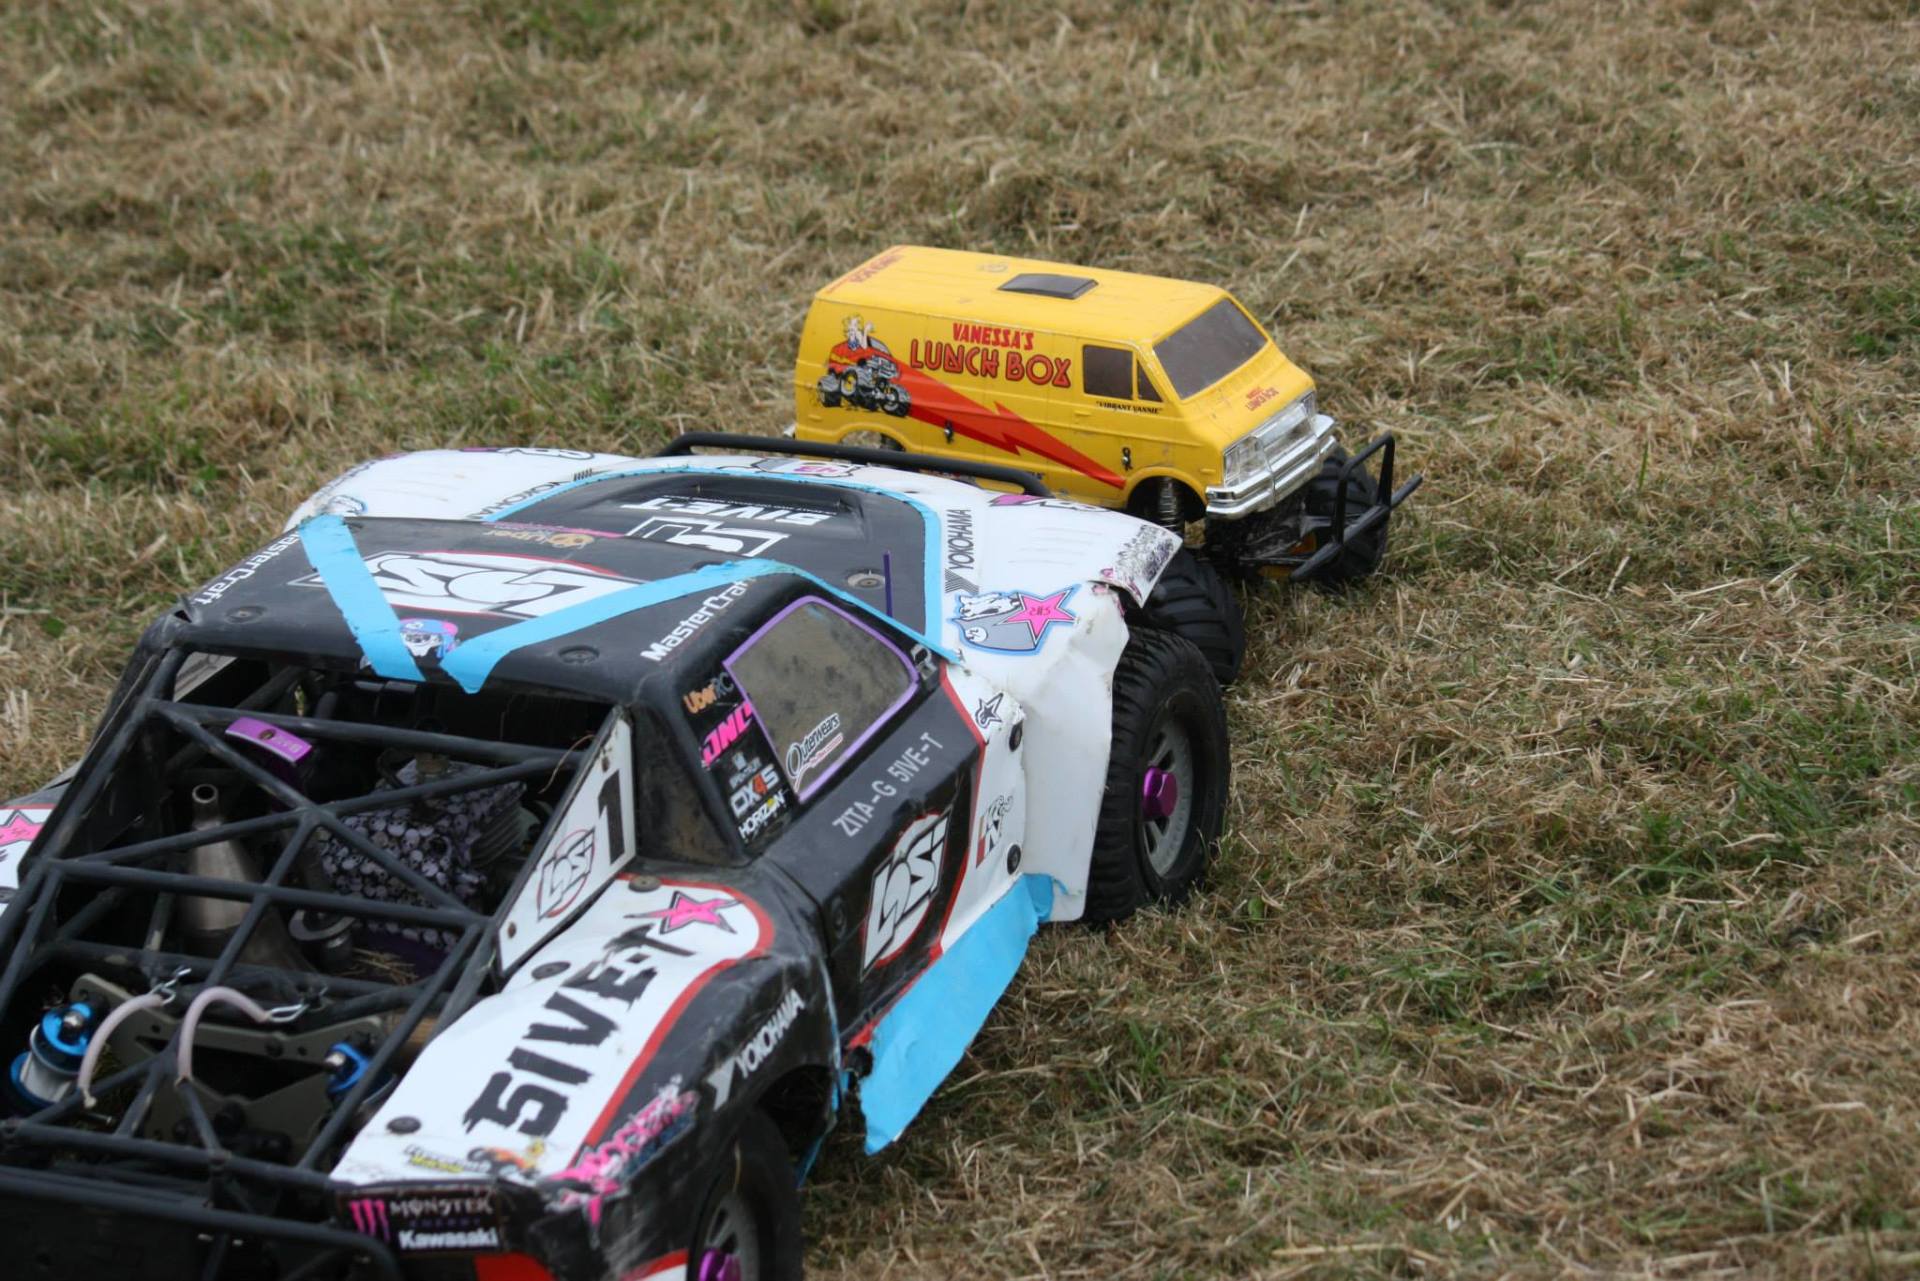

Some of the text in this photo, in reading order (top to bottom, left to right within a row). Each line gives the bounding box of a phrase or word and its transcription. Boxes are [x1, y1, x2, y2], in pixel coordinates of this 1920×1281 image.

[910, 338, 1071, 388] LUNCH BOX
[953, 322, 1034, 351] VANESSA'S
[194, 530, 301, 605] asterCraft
[946, 509, 975, 570] YOKOHAMA
[832, 780, 896, 837] ZITA-G
[887, 732, 943, 783] 5IVE-T
[735, 988, 805, 1078] YOKOHAMA
[399, 1228, 499, 1250] Kawasaki
